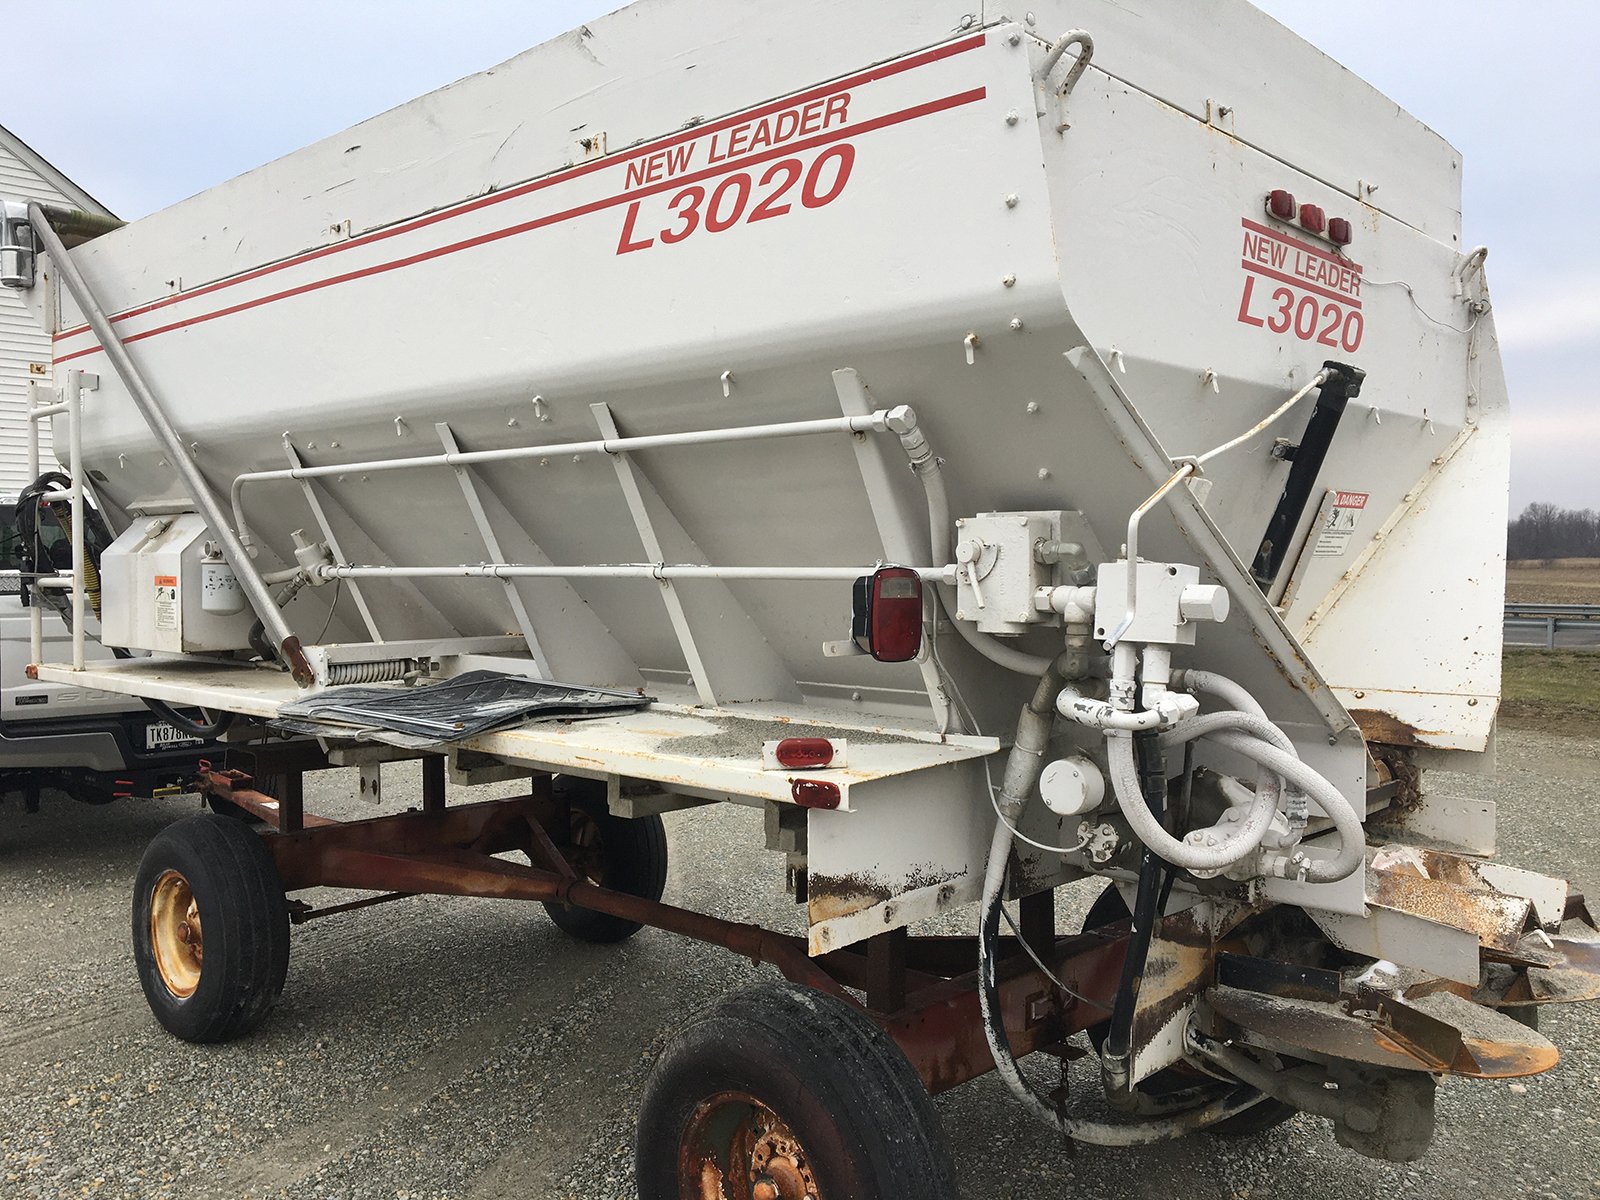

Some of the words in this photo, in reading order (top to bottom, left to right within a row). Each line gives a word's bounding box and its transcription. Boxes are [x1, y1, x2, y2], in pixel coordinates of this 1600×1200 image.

[624, 142, 696, 190] NEW
[708, 92, 851, 164] LEADER
[616, 143, 856, 256] L3020
[1242, 231, 1288, 269] NEW
[1295, 251, 1361, 297] LEADER
[1237, 275, 1364, 353] L3020
[1339, 493, 1366, 507] DANGER
